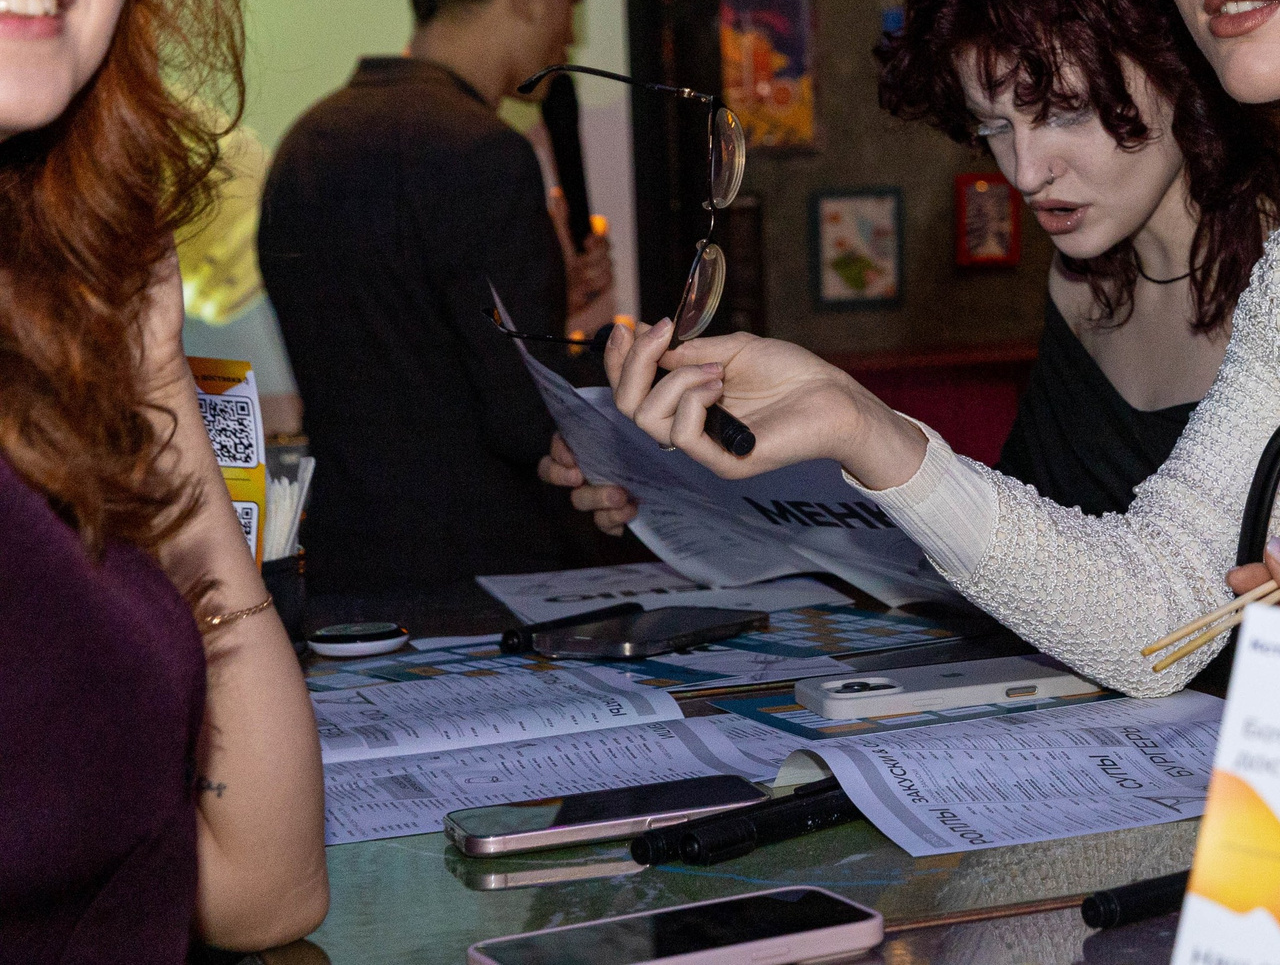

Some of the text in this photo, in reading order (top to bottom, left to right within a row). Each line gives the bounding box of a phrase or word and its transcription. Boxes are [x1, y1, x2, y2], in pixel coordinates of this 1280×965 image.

[878, 755, 929, 804] ЗАКУСКИ
[1088, 755, 1143, 789] СУПЫ
[929, 809, 994, 845] РОЛЛЫ
